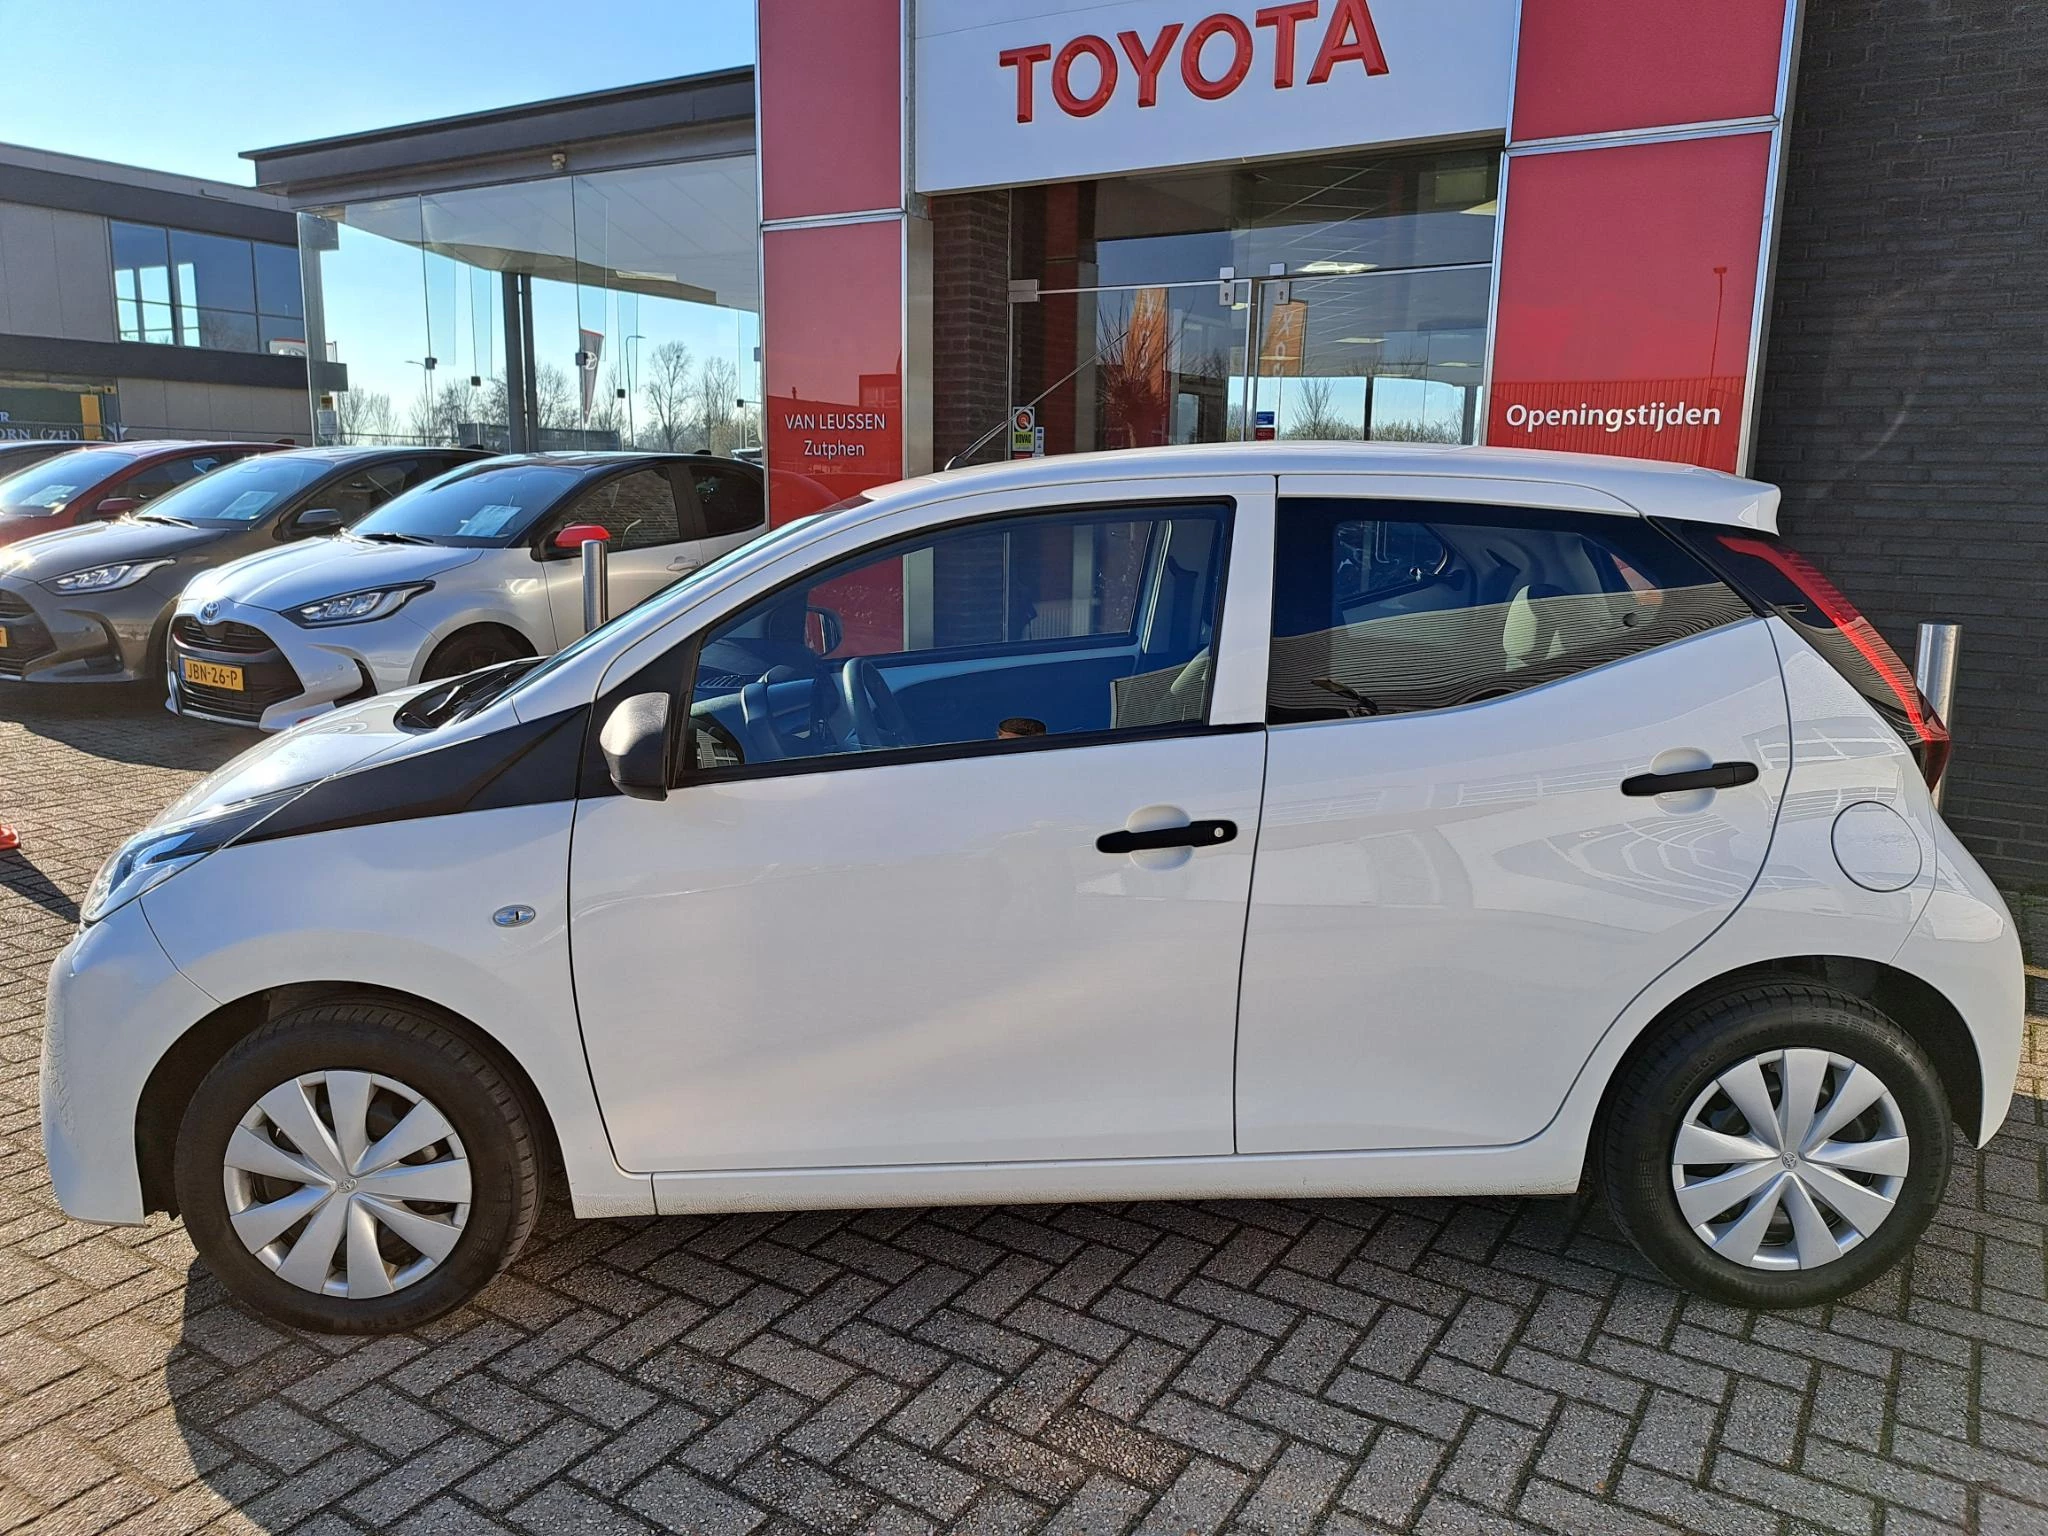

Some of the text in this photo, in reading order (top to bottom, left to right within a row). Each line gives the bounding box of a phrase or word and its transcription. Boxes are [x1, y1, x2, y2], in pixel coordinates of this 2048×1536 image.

[999, 0, 1389, 123] TOYOTA
[784, 413, 886, 430] VAN LEUSSEN
[1506, 401, 1721, 433] Openingstijden
[803, 439, 865, 460] Zutphen
[187, 662, 238, 687] JBN-26-P
